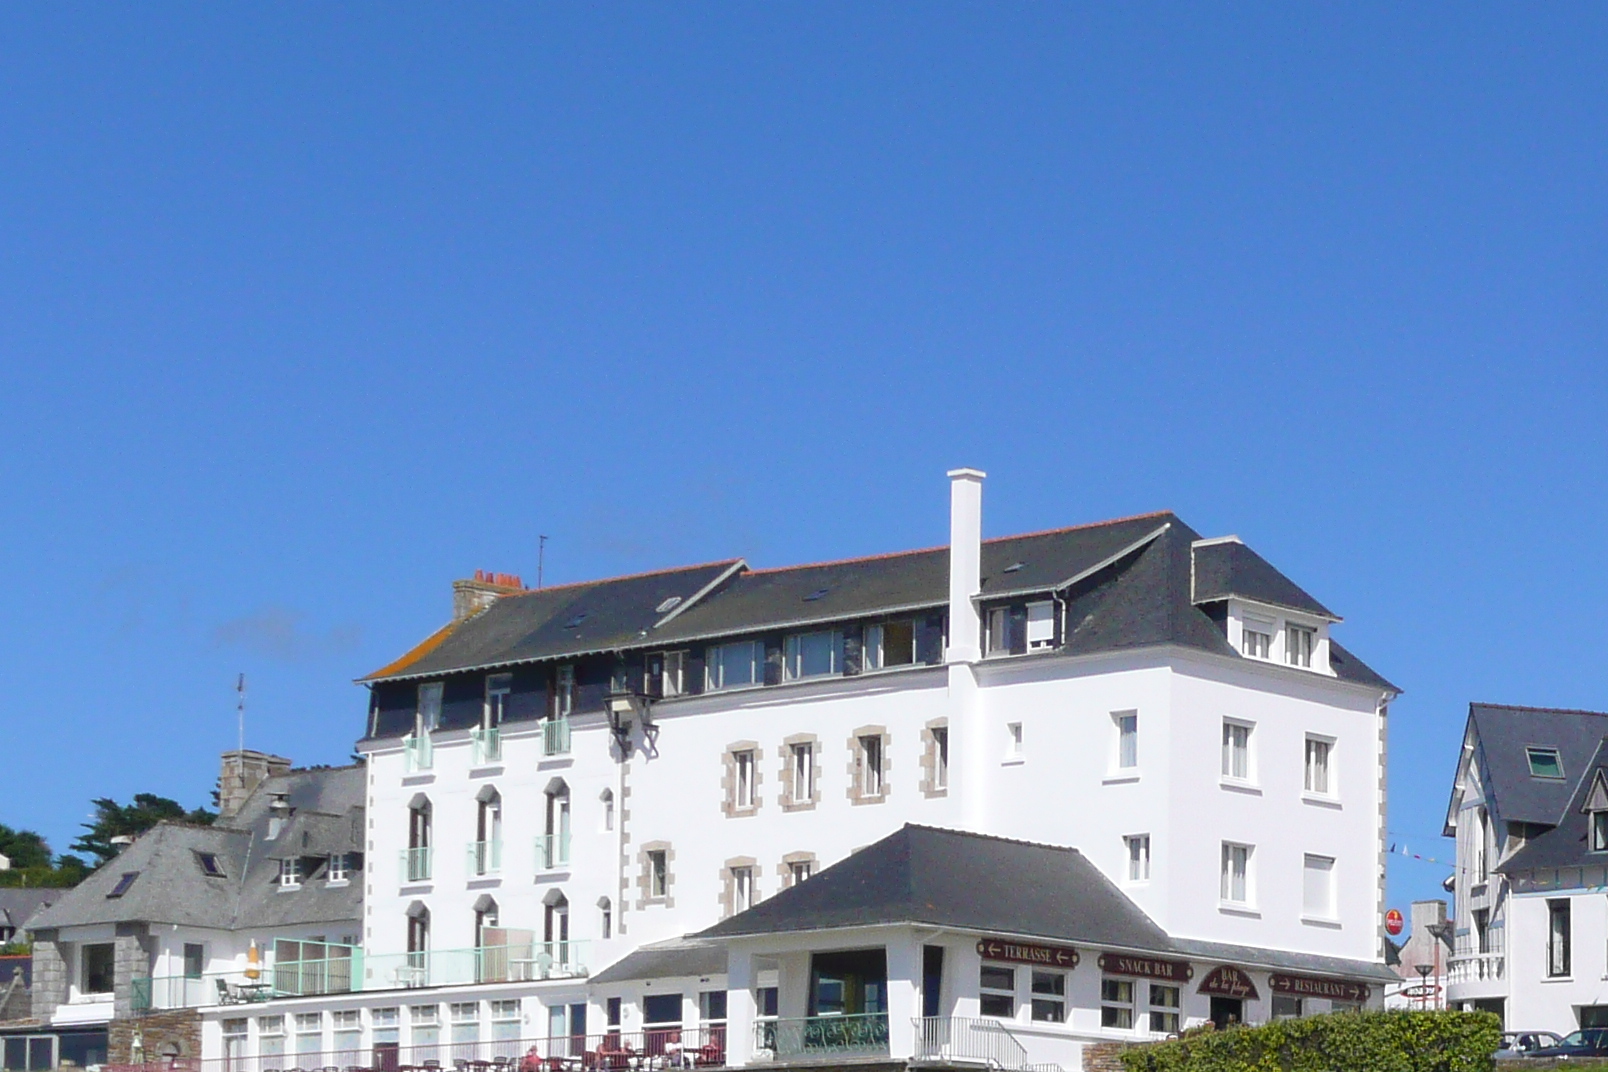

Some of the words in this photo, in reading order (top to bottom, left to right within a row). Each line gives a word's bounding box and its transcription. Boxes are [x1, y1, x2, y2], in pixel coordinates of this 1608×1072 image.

[1003, 945, 1051, 962] TERRASSE
[1119, 959, 1150, 974] SNACK
[1154, 962, 1173, 976] BAR
[1221, 968, 1238, 981] BAR
[1209, 977, 1218, 988] de
[1294, 979, 1346, 996] RESTAURANT
